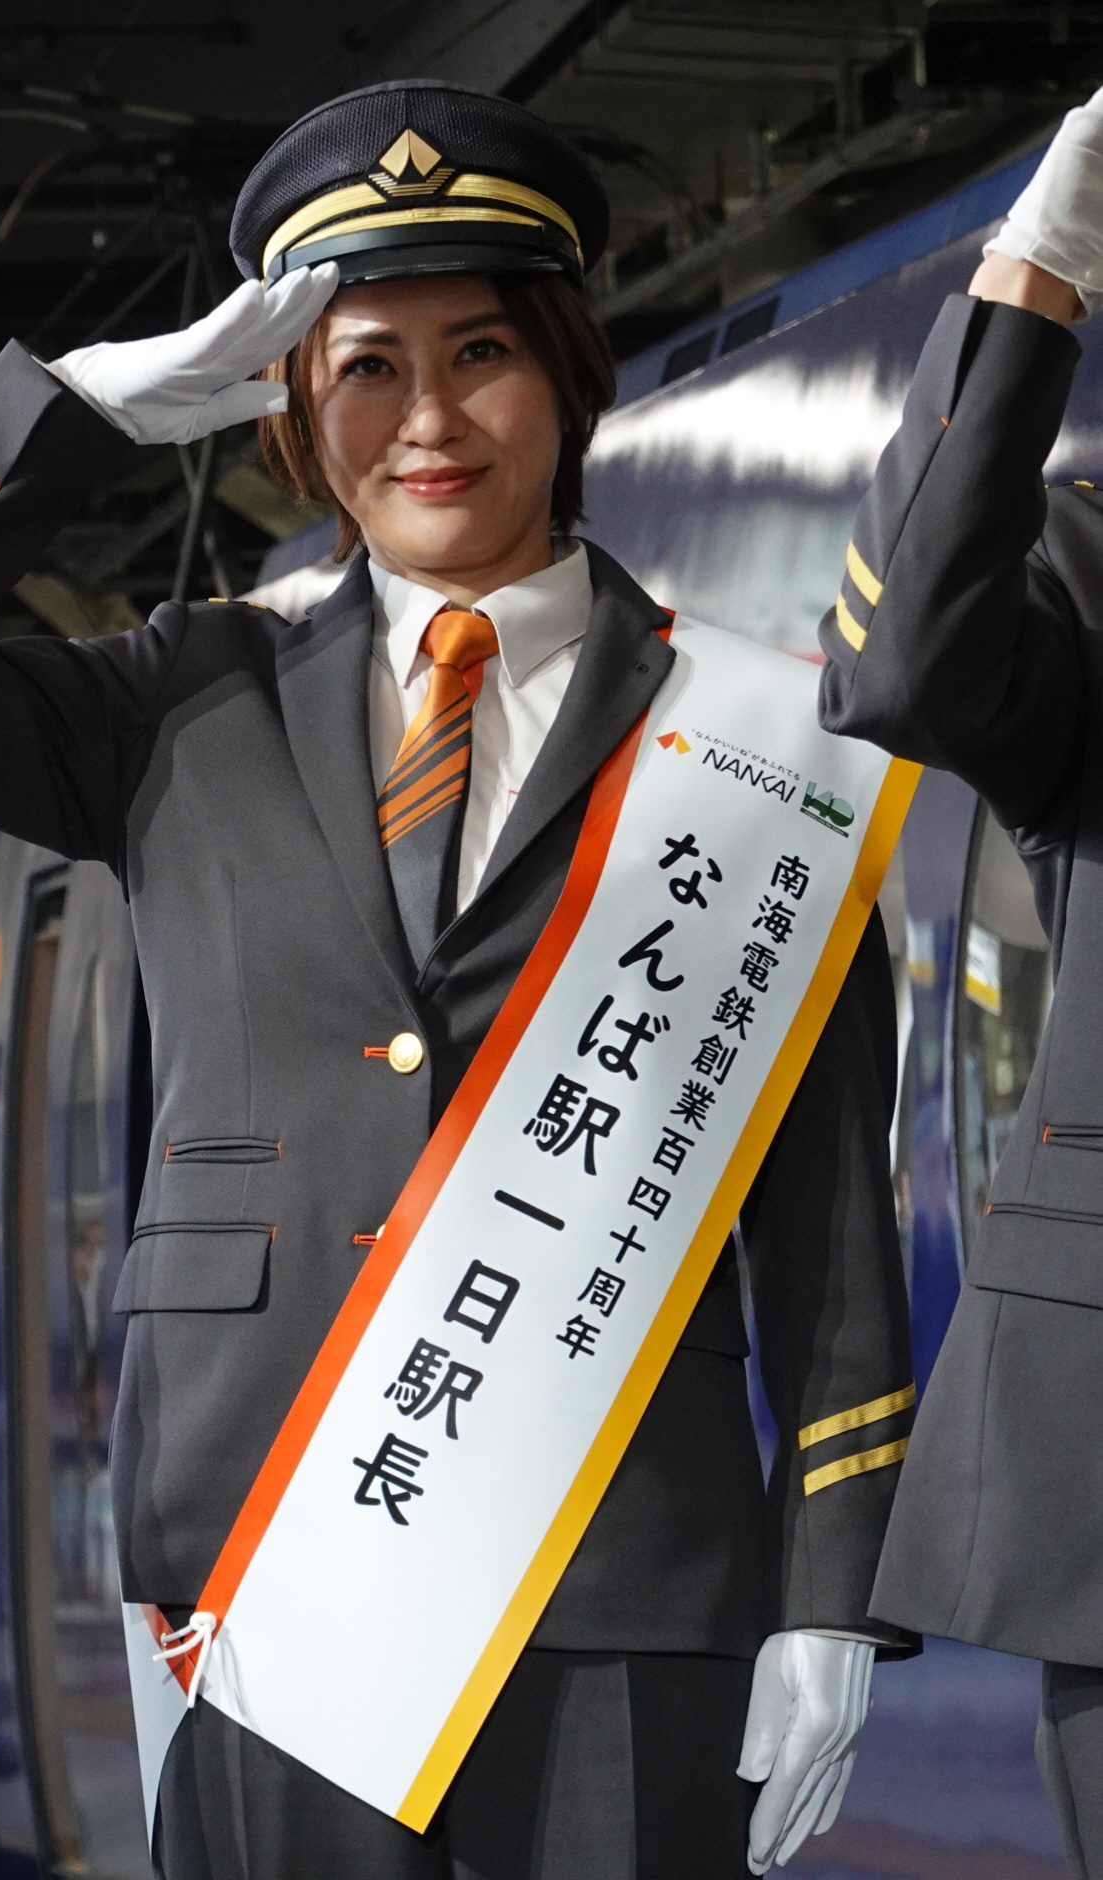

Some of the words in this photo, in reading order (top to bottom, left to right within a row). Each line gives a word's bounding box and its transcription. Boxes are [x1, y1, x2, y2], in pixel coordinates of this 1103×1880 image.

[701, 747, 797, 804] NANKAI
[353, 832, 724, 1527] なんば駅一日駅長
[555, 854, 811, 1361] 南海電鉄創業百四十周年
